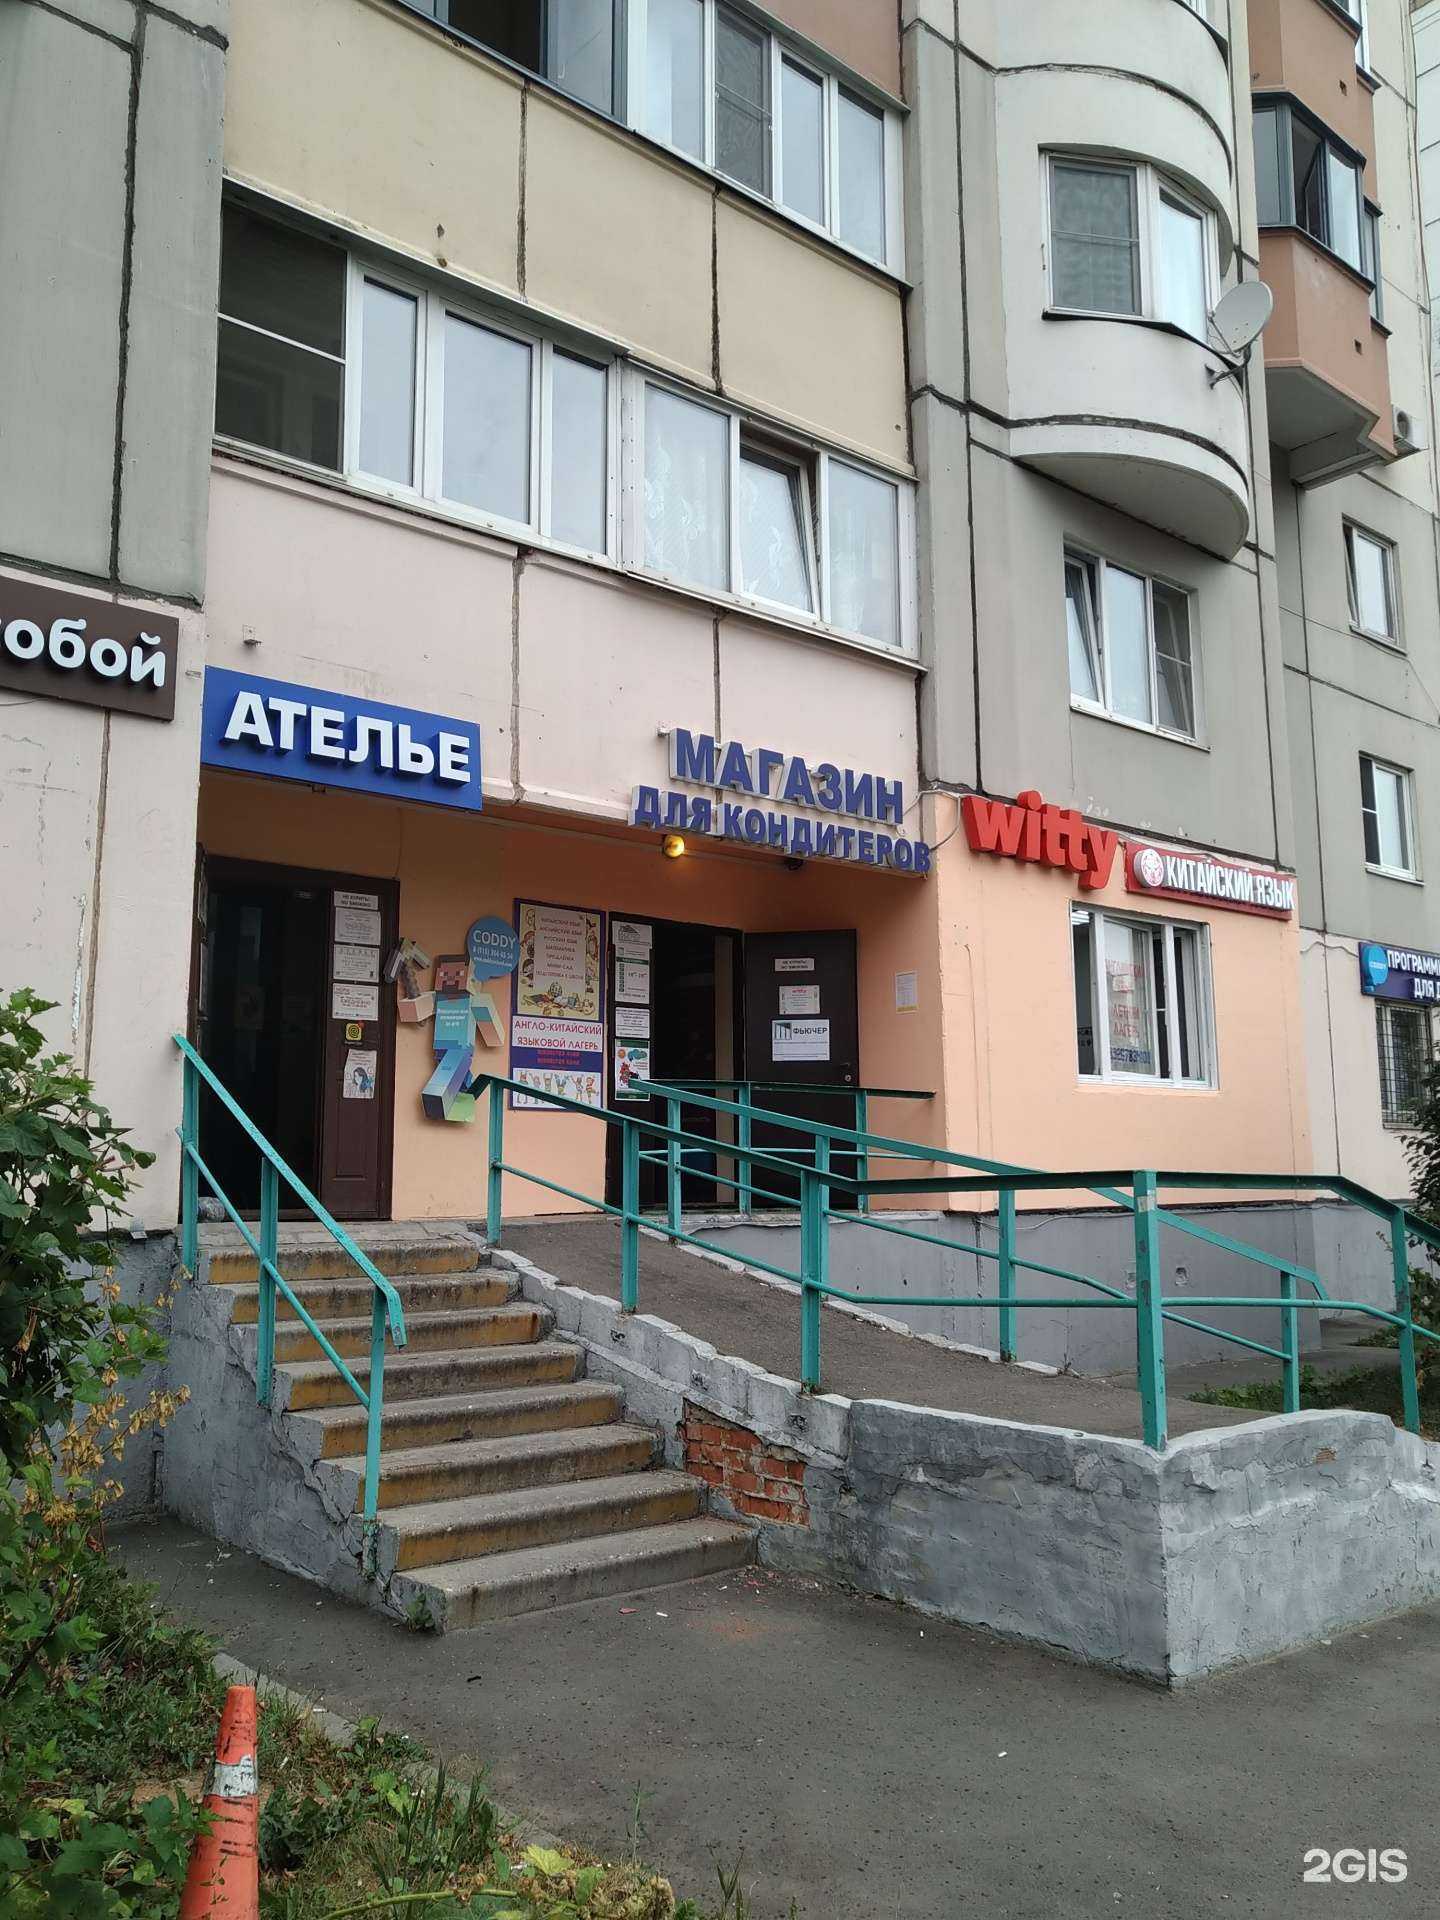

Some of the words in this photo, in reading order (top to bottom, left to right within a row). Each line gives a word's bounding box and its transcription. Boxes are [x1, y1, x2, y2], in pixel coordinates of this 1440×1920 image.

[0, 617, 167, 688] обой
[224, 690, 471, 784] АТЕЛЬЕ
[669, 727, 903, 825] МАГАЗИН
[628, 784, 712, 833] ДЛЯ
[717, 802, 931, 873] КОНДИТЕРОВ
[961, 790, 1120, 890] witty
[1166, 854, 1254, 904] КИТАЙСКИЙ
[1255, 873, 1296, 910] ЯЗЫК
[473, 929, 516, 950] CODDY
[1413, 977, 1435, 999] ДЛЯ
[514, 1020, 602, 1036] АНГЛО-КИТАЙСКИЙ
[517, 1036, 566, 1049] ЯЗЫКОВОЙ
[568, 1039, 599, 1050] ЛАГЕРЬ
[793, 1026, 828, 1036] ФЬЮЧЕР
